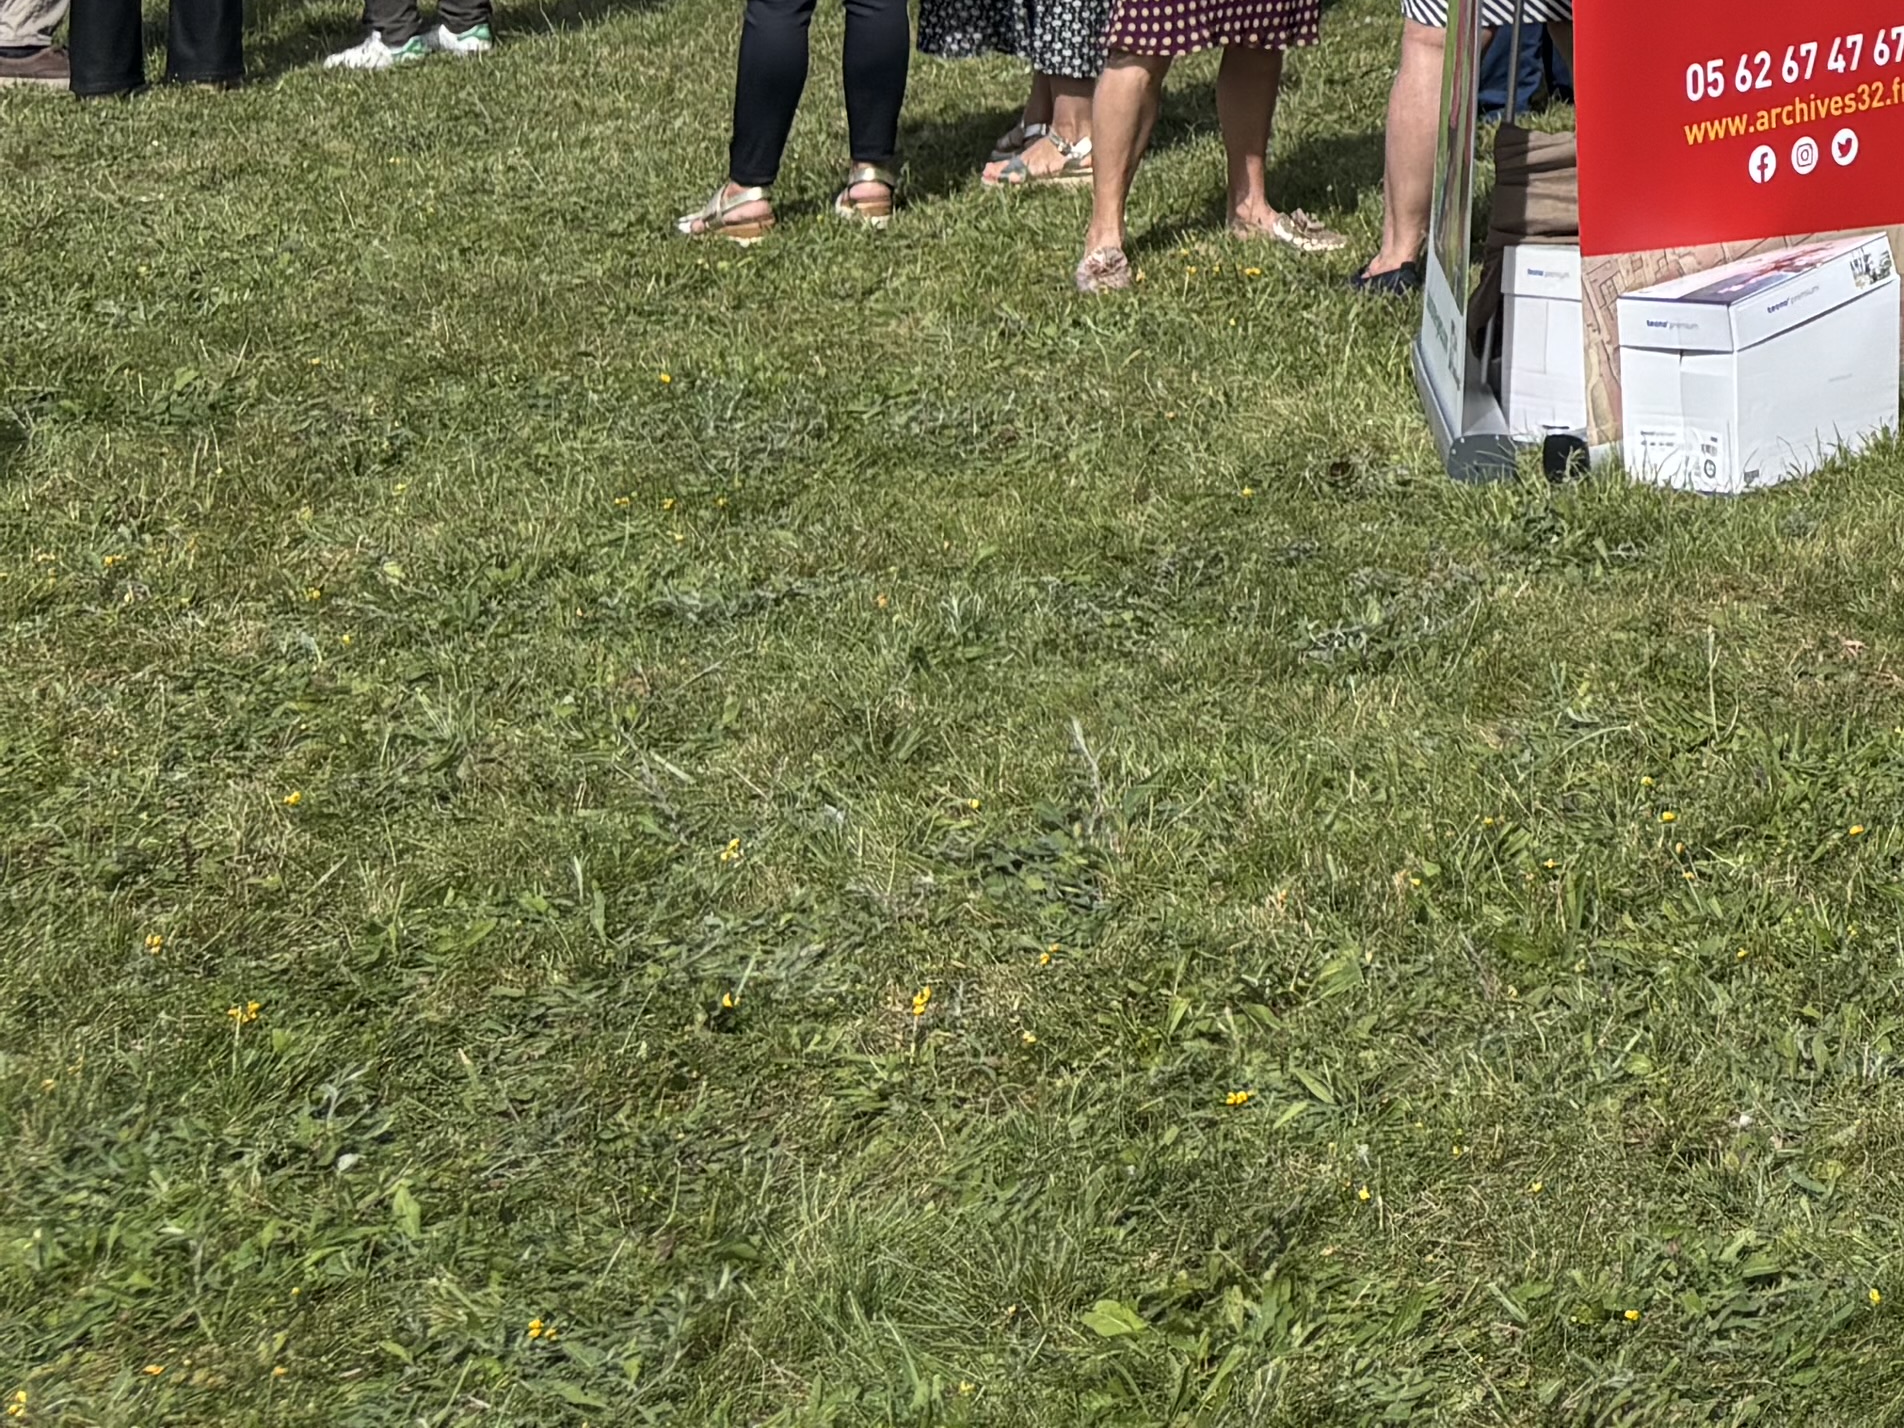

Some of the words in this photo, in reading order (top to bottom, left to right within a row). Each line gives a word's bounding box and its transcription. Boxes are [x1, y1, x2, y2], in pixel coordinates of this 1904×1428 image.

[1686, 59, 1725, 101] 05
[1735, 51, 1772, 93] 62
[1782, 42, 1818, 84] 67
[1827, 34, 1863, 73] 47
